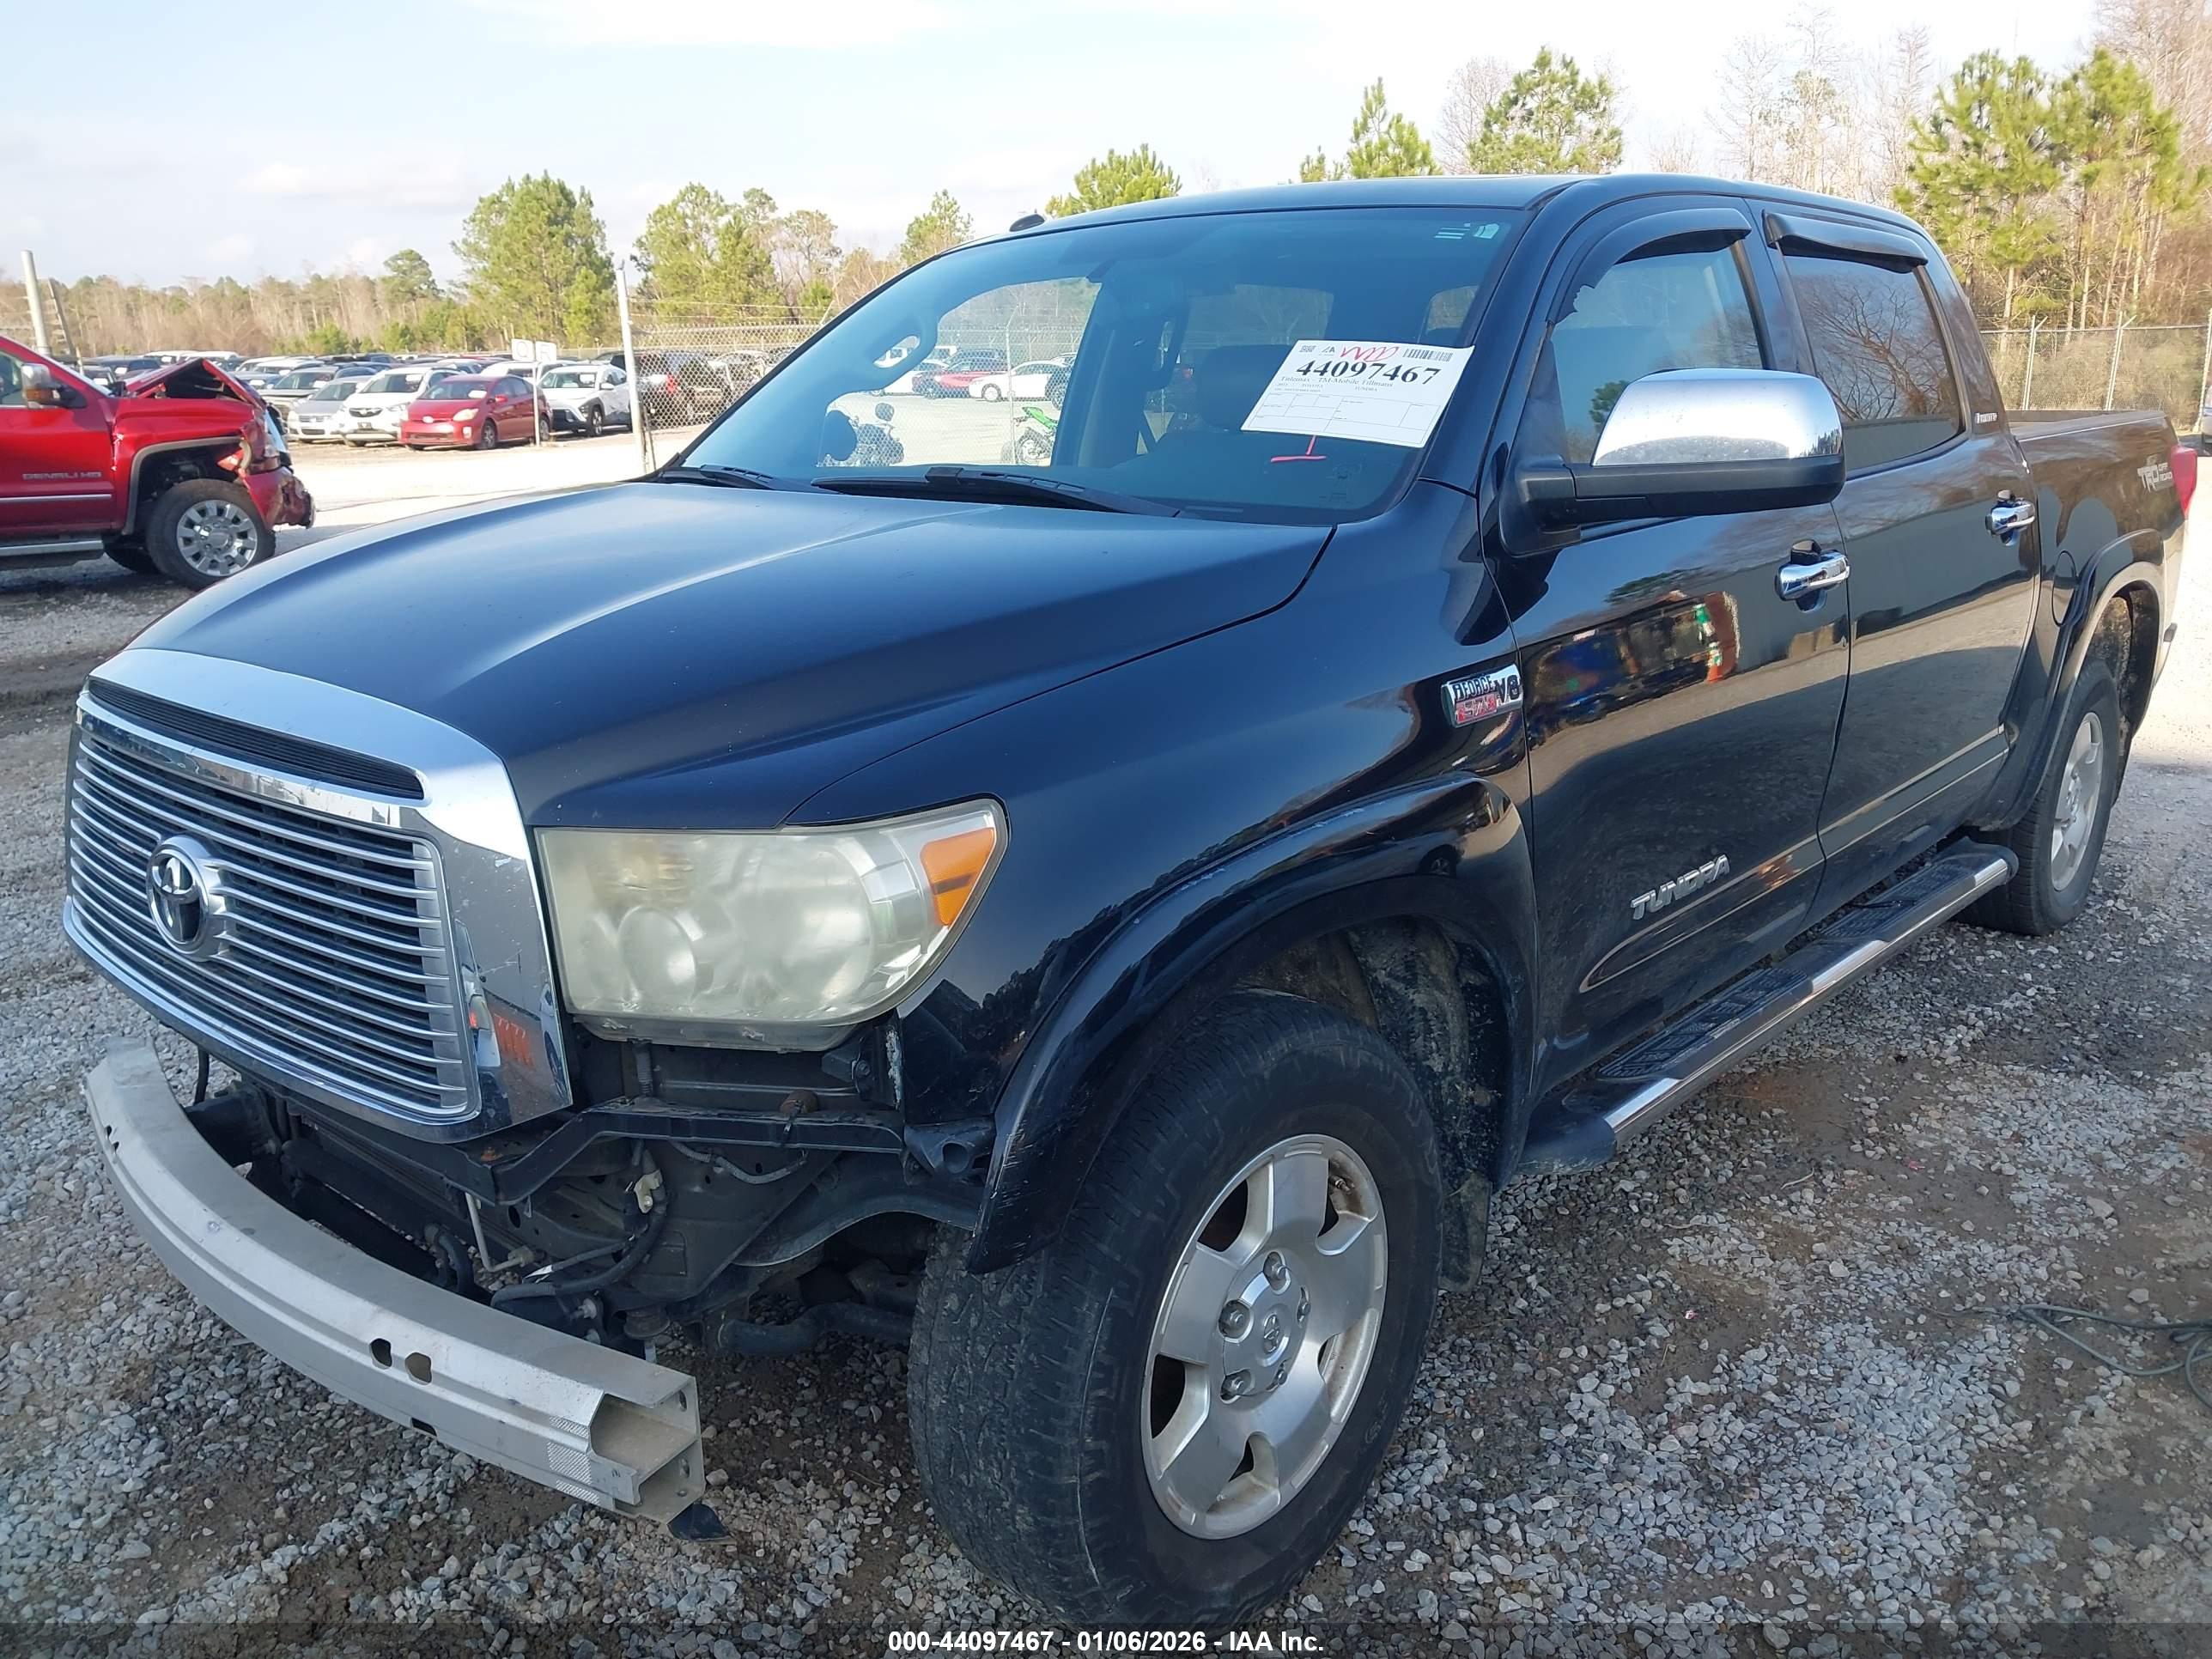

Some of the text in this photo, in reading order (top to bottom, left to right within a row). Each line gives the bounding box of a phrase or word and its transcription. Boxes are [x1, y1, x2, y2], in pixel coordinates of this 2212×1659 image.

[1296, 360, 1442, 385] 44097467
[1493, 675, 1521, 705] V8
[1631, 854, 1730, 921] TUNDRA
